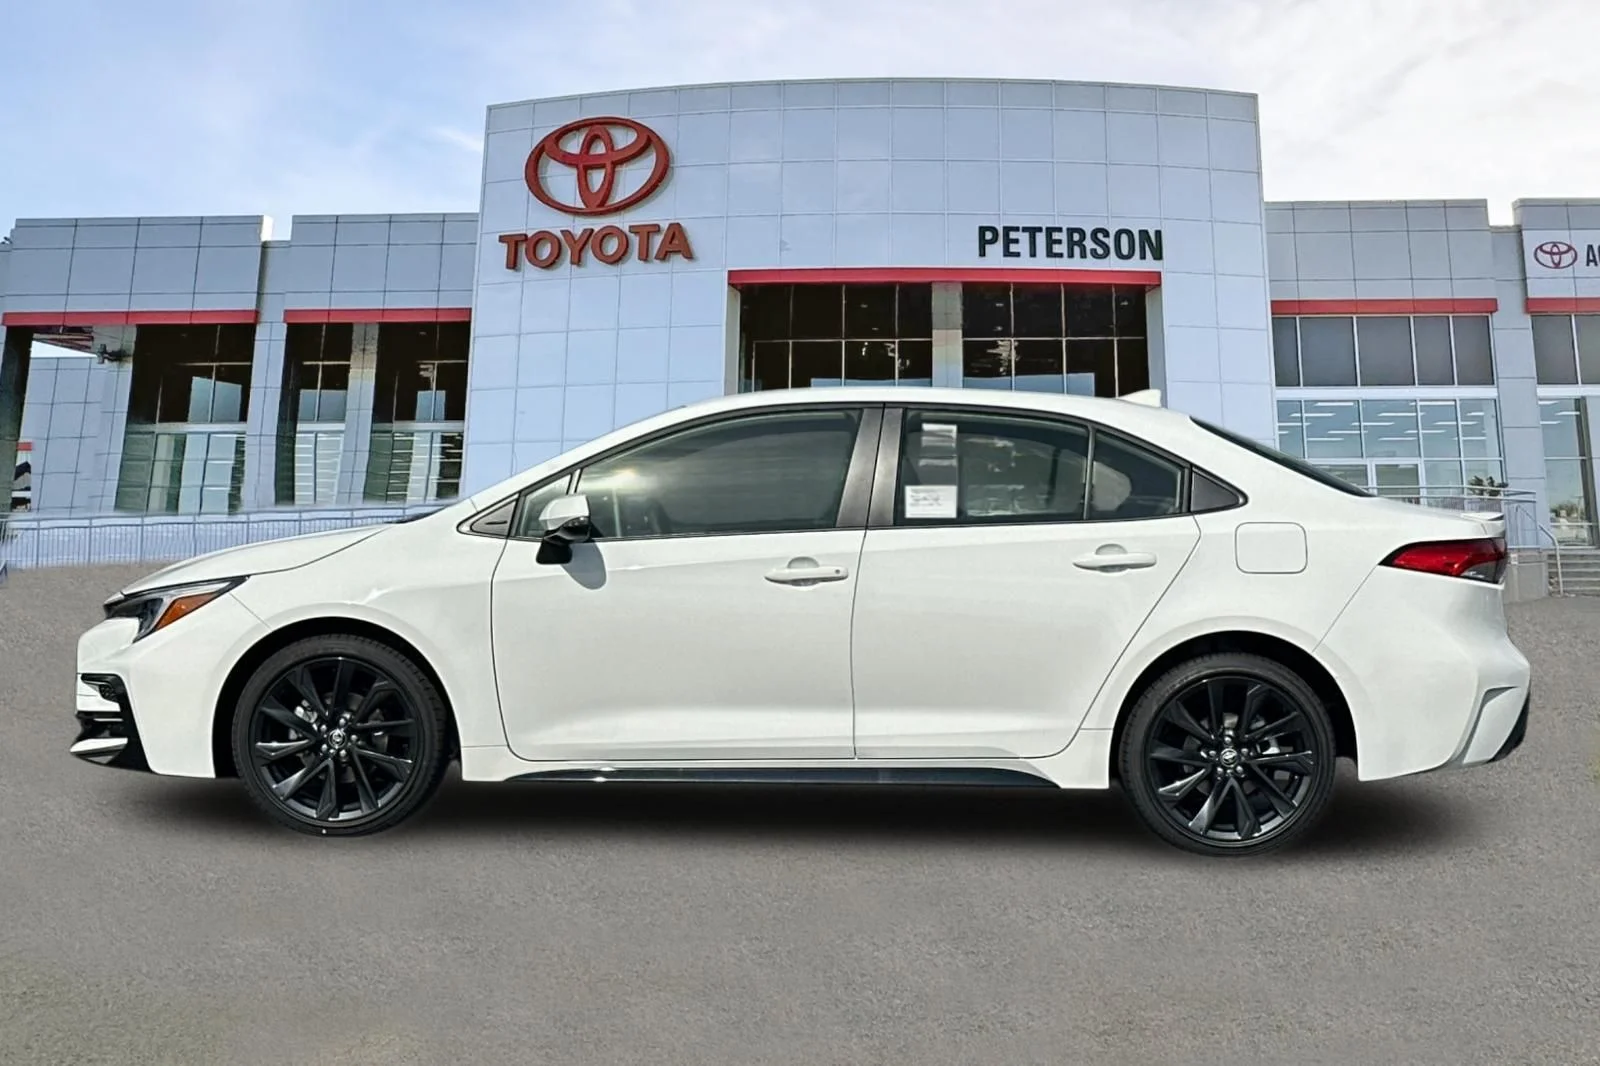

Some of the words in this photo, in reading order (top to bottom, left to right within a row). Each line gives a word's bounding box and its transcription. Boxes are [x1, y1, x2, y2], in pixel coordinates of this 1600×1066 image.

[499, 222, 694, 270] TOYOTA
[978, 225, 1163, 261] PETERSON
[1586, 244, 1600, 267] A
